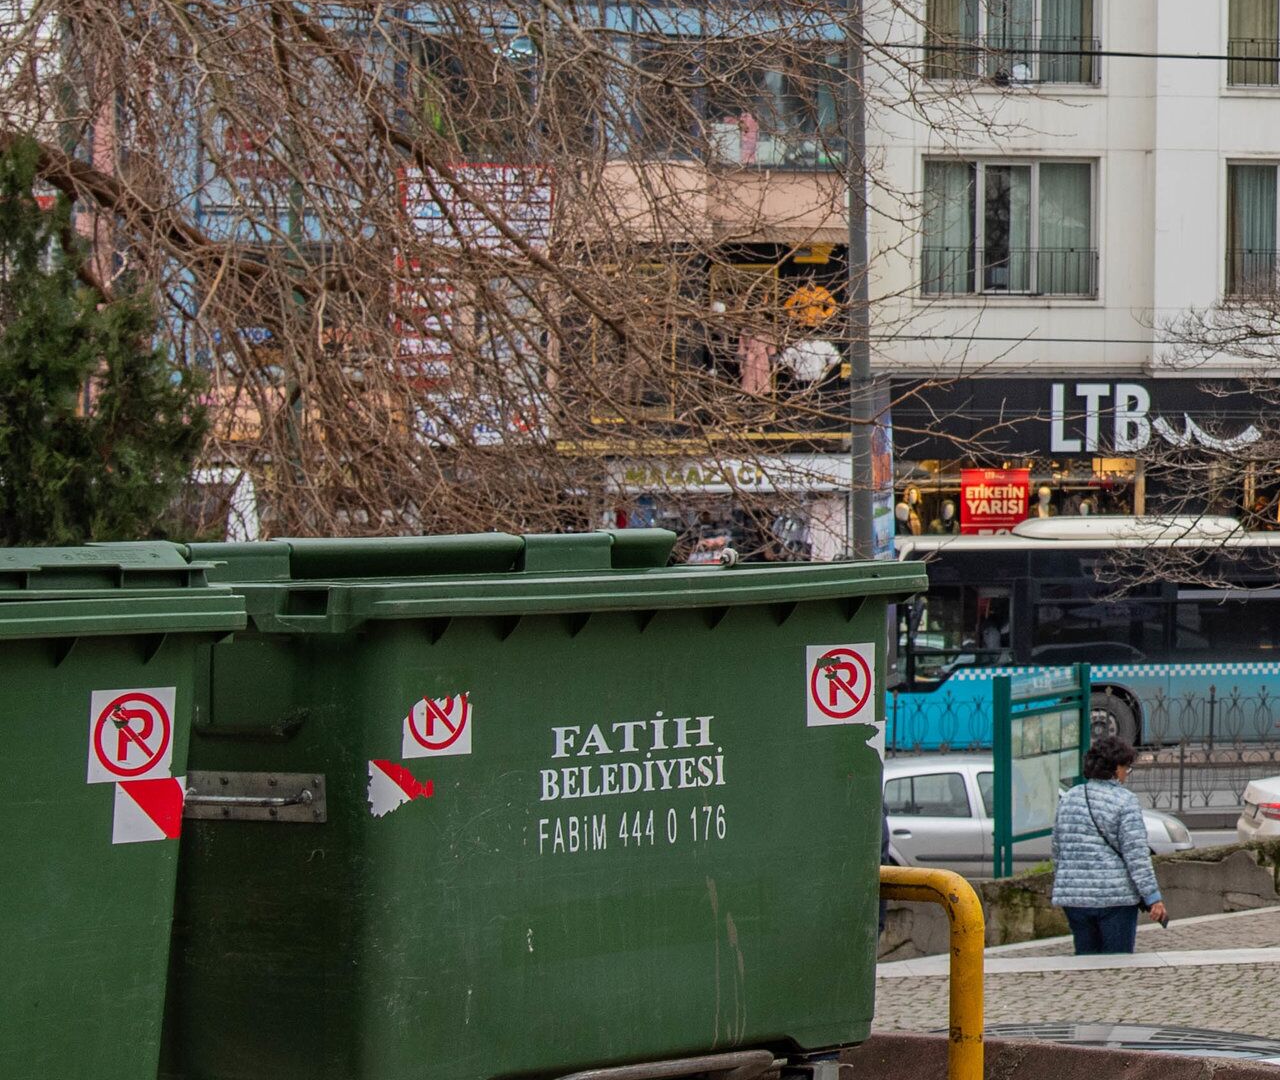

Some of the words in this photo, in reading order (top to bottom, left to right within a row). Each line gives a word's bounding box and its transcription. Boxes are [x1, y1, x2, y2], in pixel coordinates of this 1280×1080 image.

[1051, 383, 1150, 452] LTB
[965, 483, 1025, 499] ETİKETİN
[966, 500, 1025, 515] YARISI
[551, 711, 714, 758] FATİH
[540, 747, 726, 801] BELEDİYESİ
[619, 810, 654, 847] 444
[667, 808, 677, 843] 0
[690, 804, 726, 841] 176
